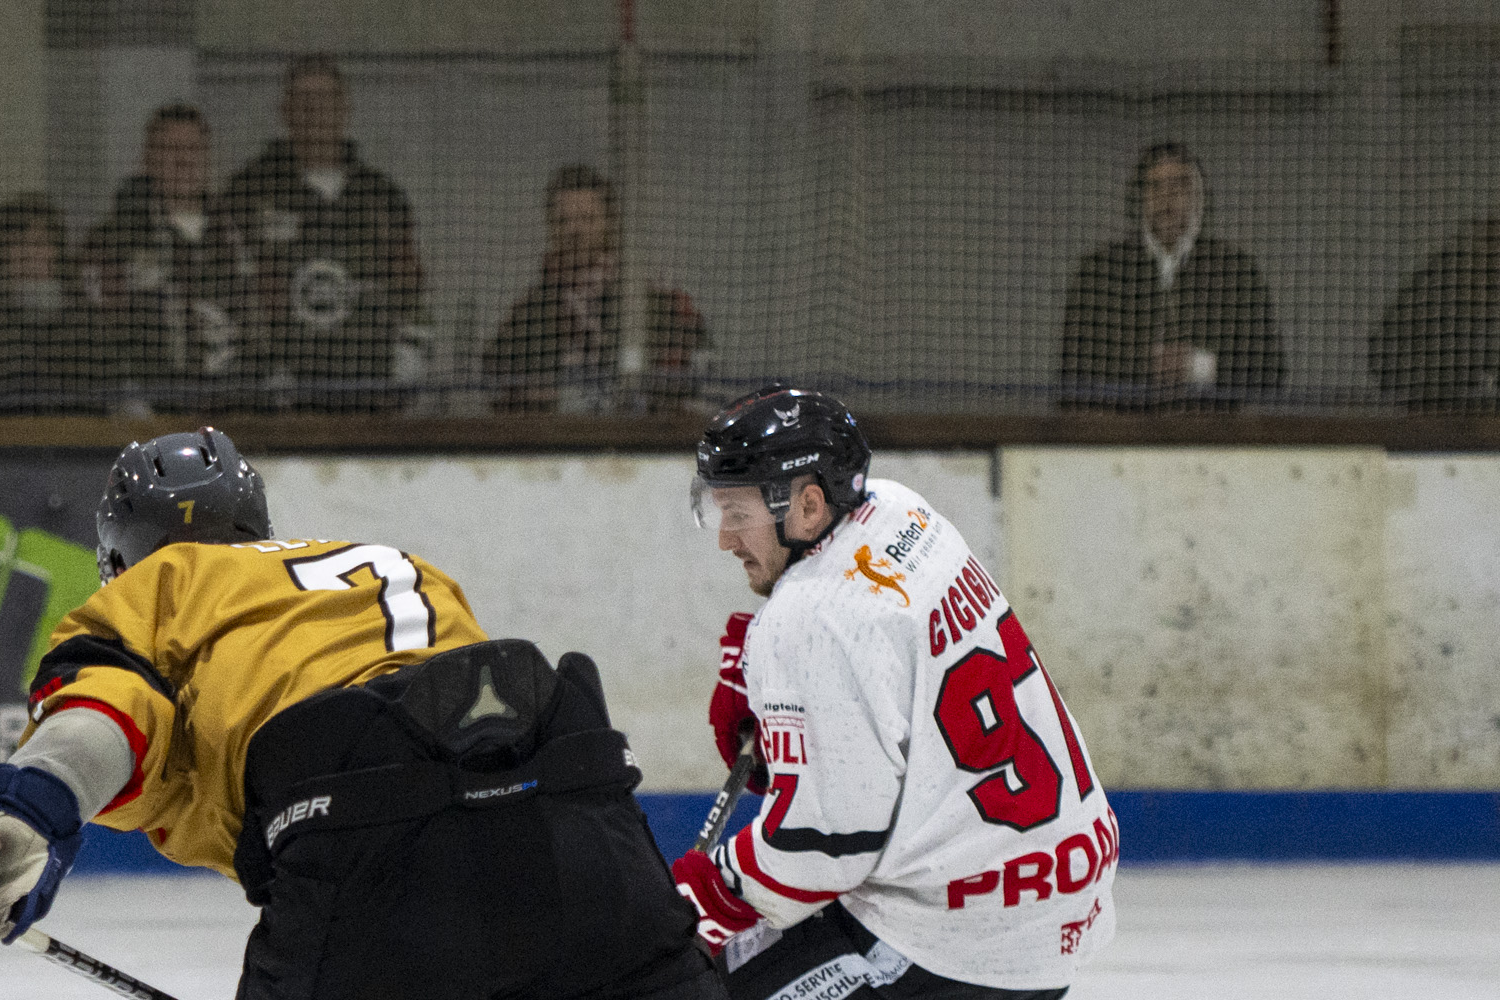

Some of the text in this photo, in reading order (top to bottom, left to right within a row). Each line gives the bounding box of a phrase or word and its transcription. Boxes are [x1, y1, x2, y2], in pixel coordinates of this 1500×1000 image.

[781, 452, 820, 471] CCM
[177, 500, 195, 524] 7
[283, 543, 438, 654] 7
[934, 606, 1095, 833] 97
[464, 783, 524, 801] NEXUS
[699, 790, 730, 840] CCM
[265, 795, 332, 850] BAUER
